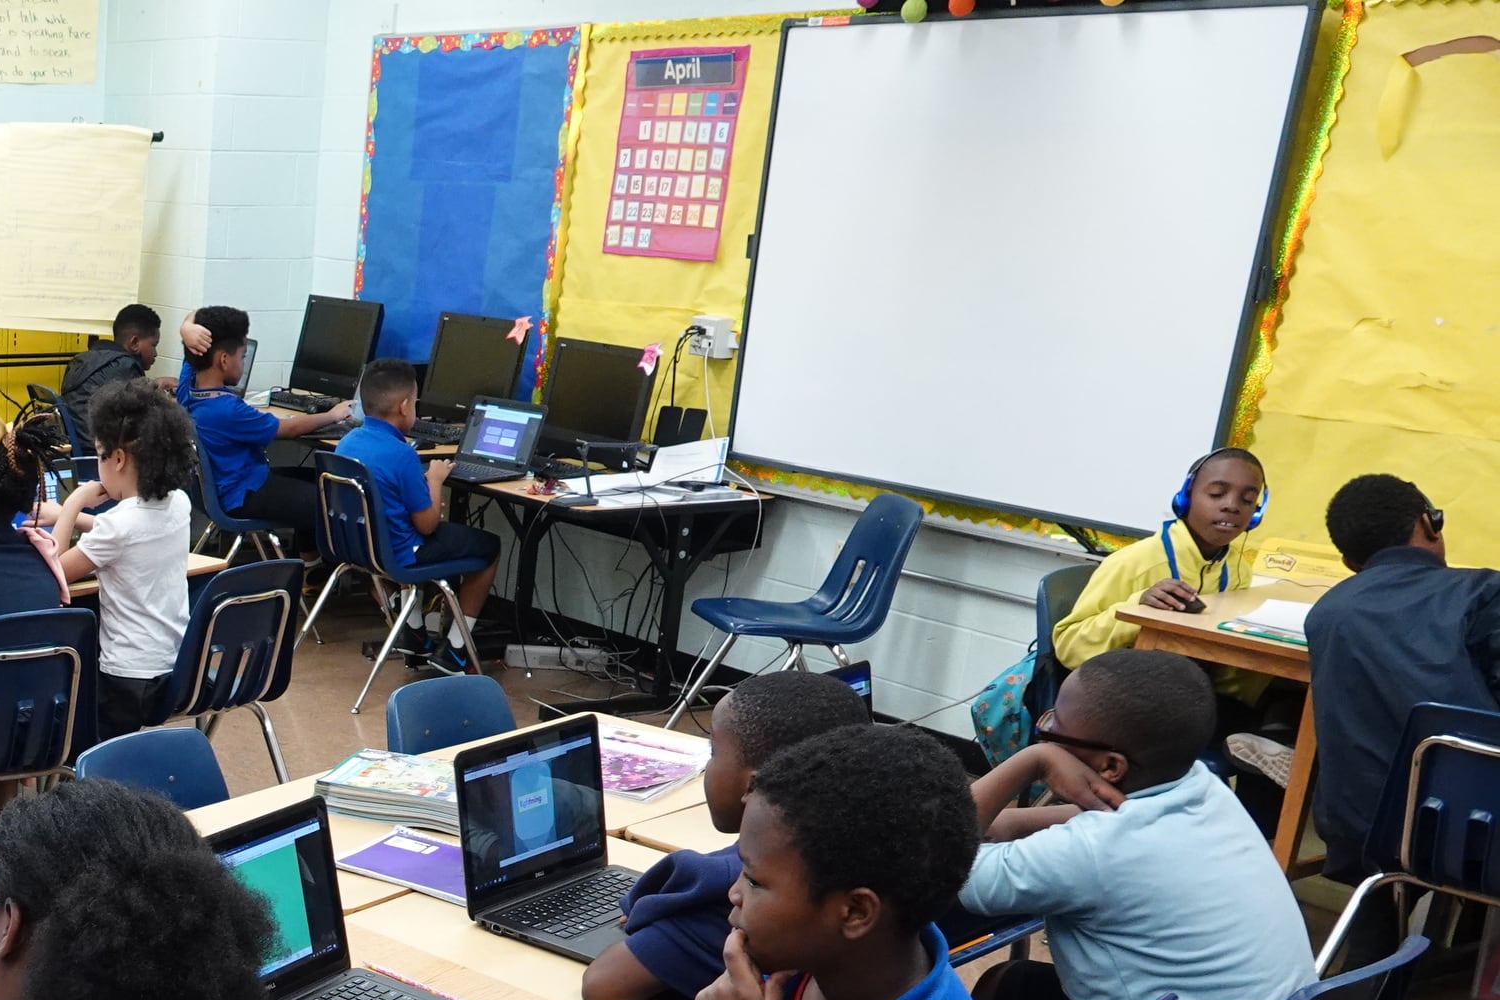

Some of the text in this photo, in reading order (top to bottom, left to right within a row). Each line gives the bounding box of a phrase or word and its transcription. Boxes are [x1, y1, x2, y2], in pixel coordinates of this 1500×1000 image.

[20, 10, 37, 23] talk
[9, 27, 18, 36] is
[21, 27, 64, 43] speaking
[30, 45, 39, 56] to
[12, 65, 23, 77] do
[30, 70, 46, 80] your
[52, 67, 73, 77] best
[664, 58, 701, 84] April
[718, 128, 724, 138] 6
[623, 152, 629, 163] 7
[654, 155, 660, 164] 9
[632, 180, 640, 190] 15
[661, 182, 669, 192] 17
[628, 207, 638, 217] 22
[642, 208, 652, 218] 23
[672, 210, 682, 220] 25
[640, 232, 649, 243] 30
